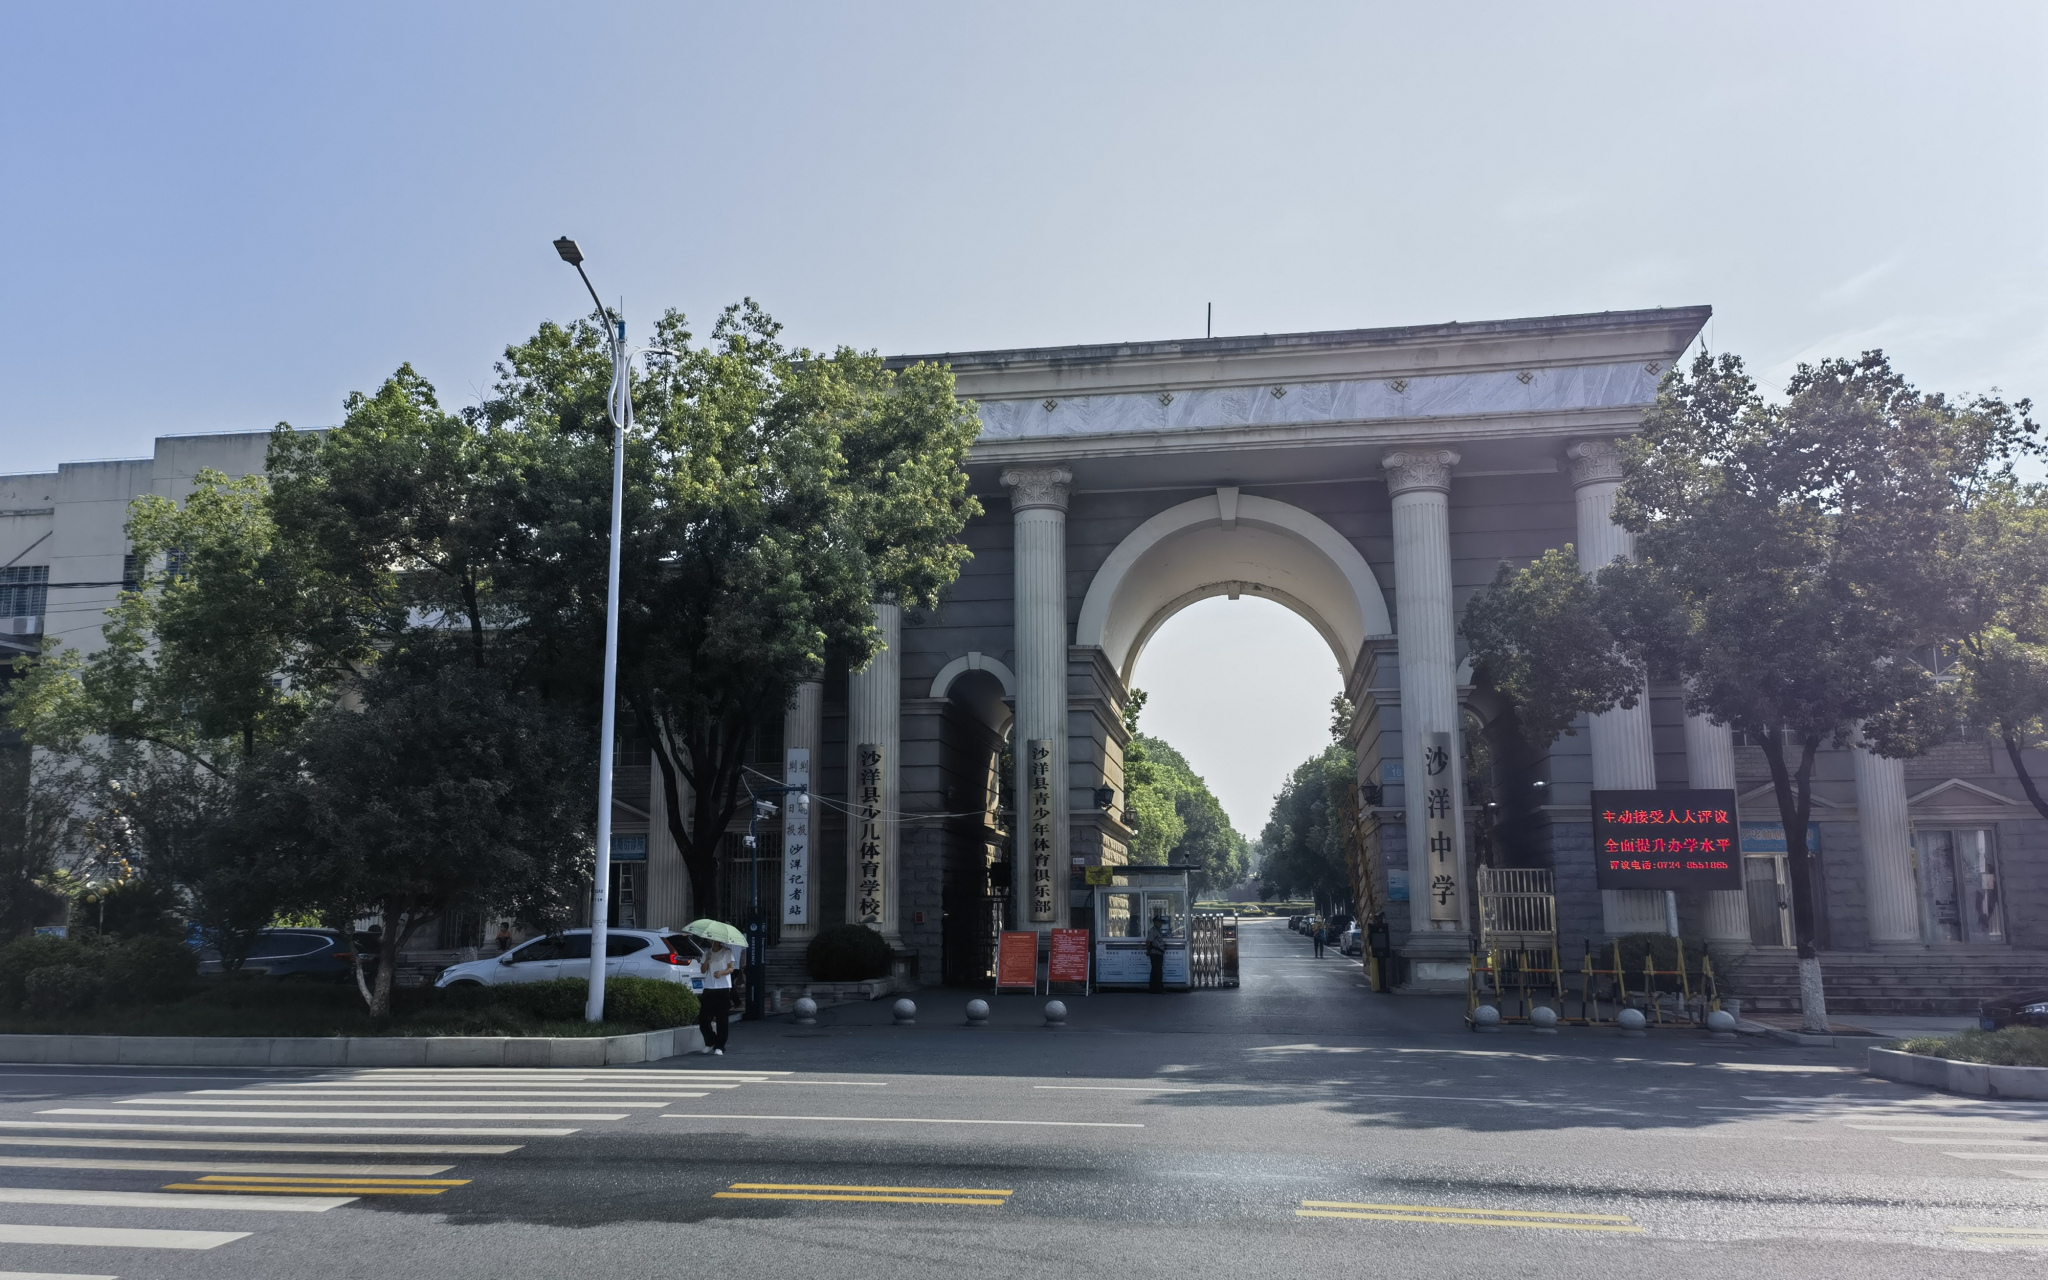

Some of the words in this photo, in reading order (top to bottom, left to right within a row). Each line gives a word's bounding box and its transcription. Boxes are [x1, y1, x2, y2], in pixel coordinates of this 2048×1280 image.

[788, 844, 804, 916] 沙洋记者站
[859, 750, 882, 916] 沙洋县少儿体育学校
[1032, 747, 1052, 914] 沙洋县青少年体育俱乐部
[1424, 746, 1456, 906] 沙洋中学
[1604, 838, 1731, 853] 全面提升办学水平
